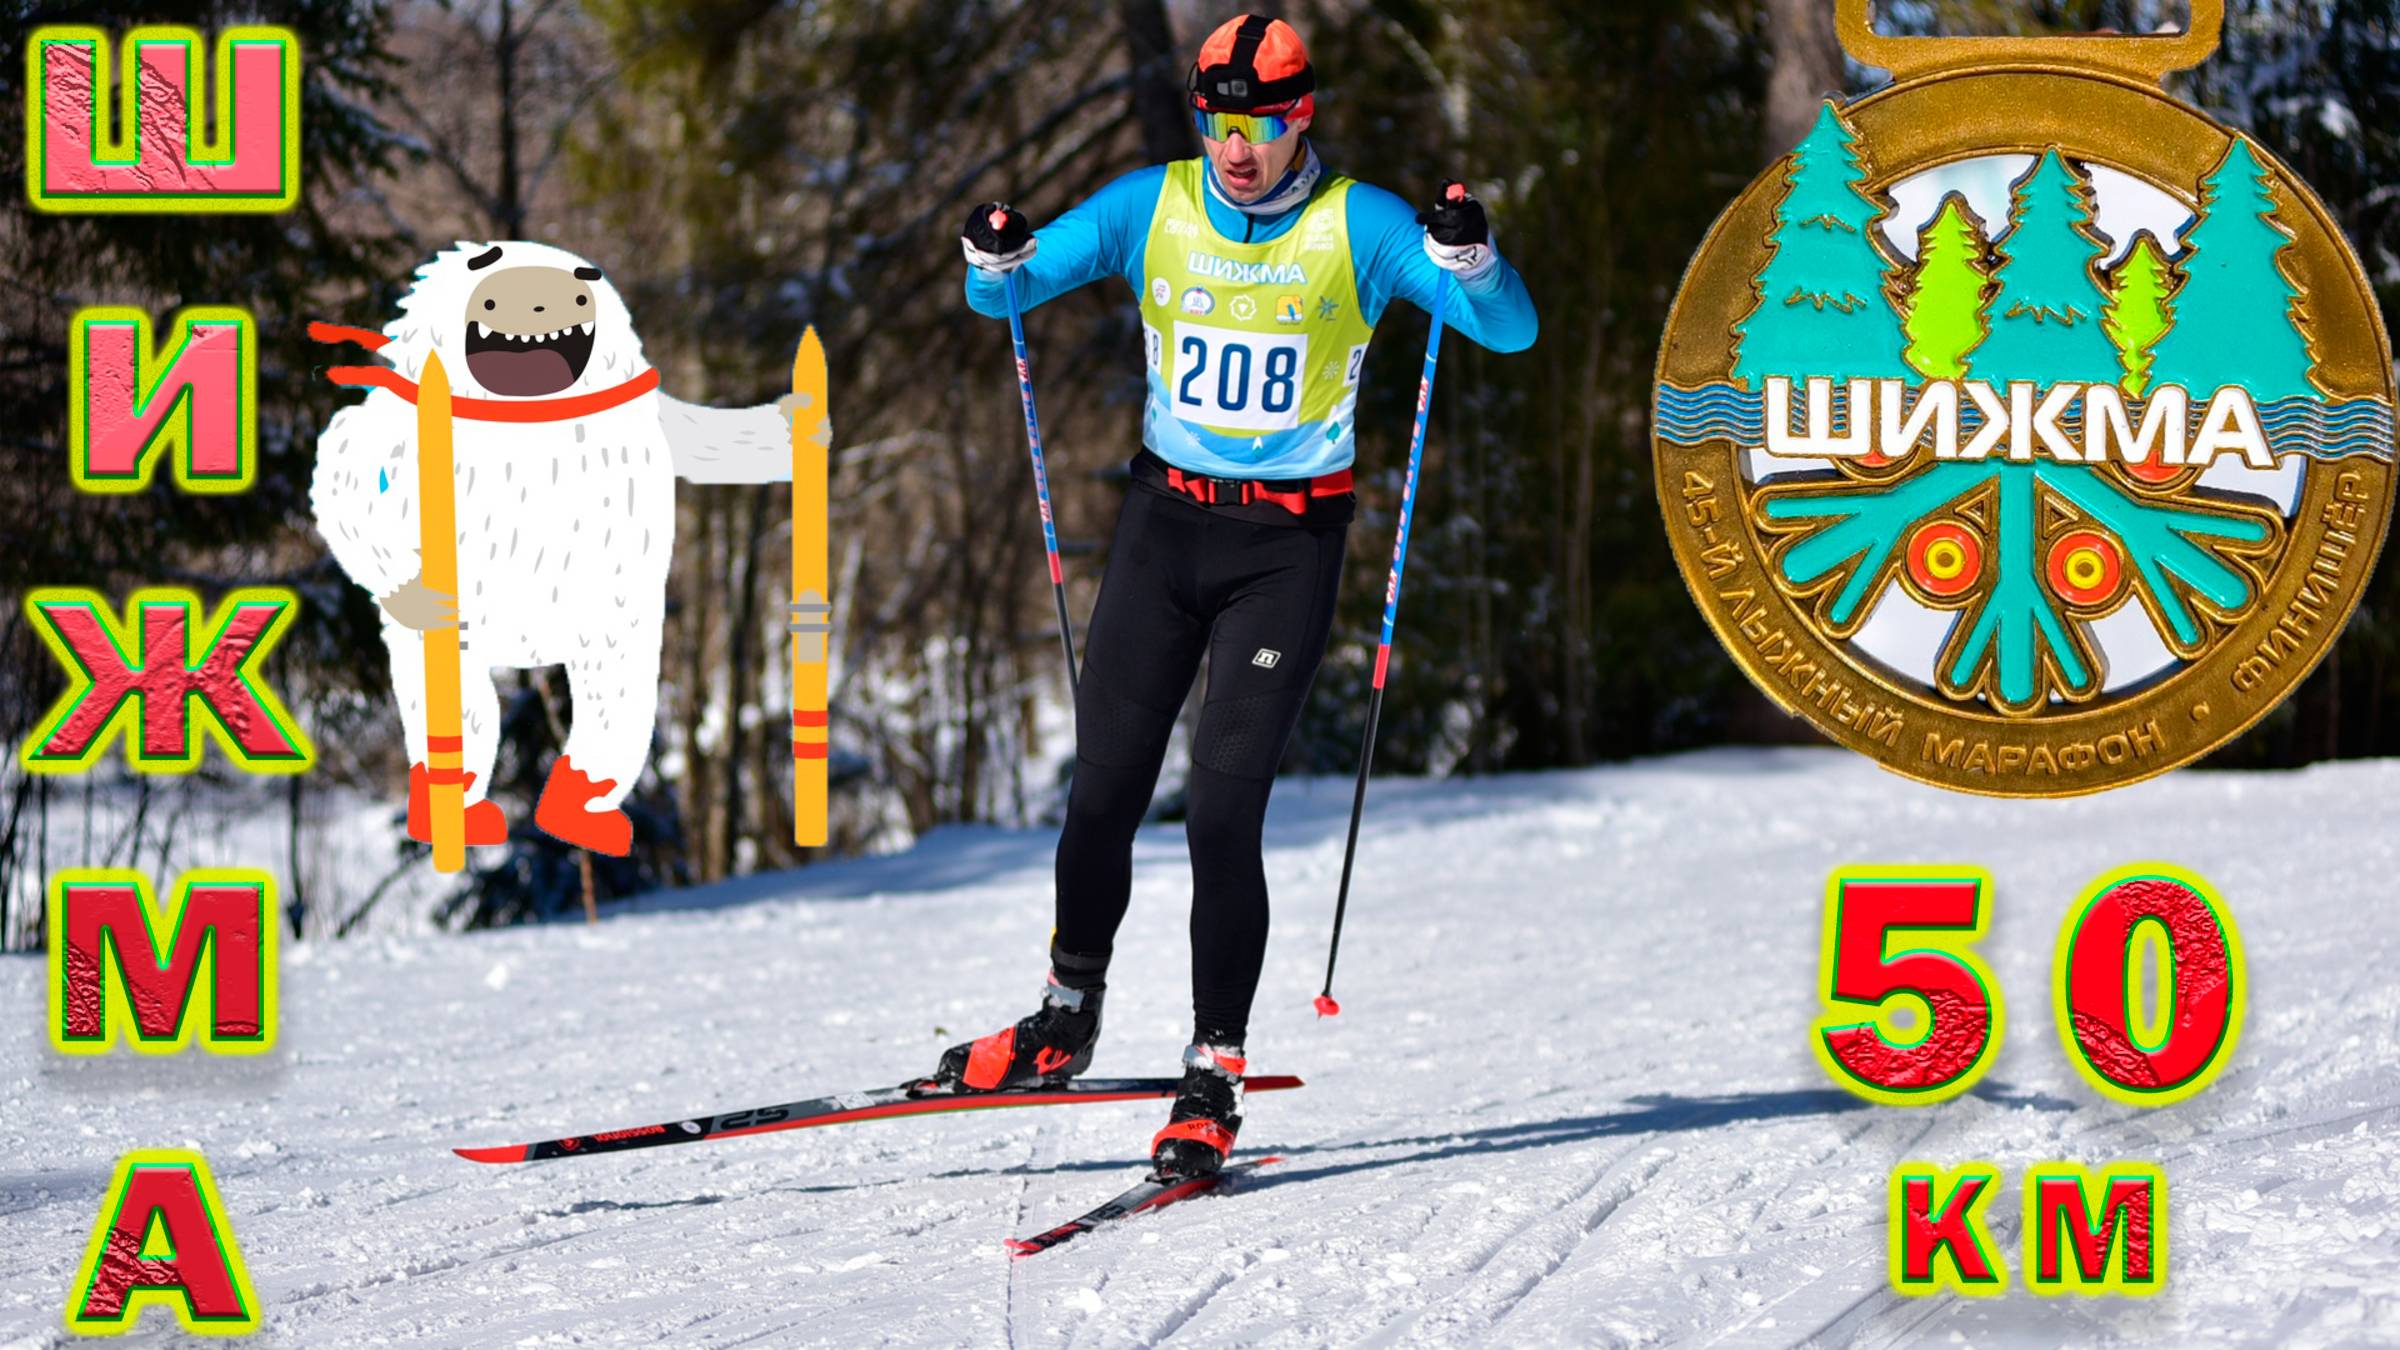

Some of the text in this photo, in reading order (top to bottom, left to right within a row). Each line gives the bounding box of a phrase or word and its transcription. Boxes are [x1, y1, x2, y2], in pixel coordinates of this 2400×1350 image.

[1188, 250, 1308, 285] ШИЖМА
[1178, 336, 1297, 413] 208
[1348, 348, 1362, 381] 2
[1764, 374, 2277, 469] ШИЖМА
[1682, 471, 2167, 776] 45-Й ЛЫЖНЫЙ МАРАФОН
[2230, 471, 2370, 692] ФИНИШЁР
